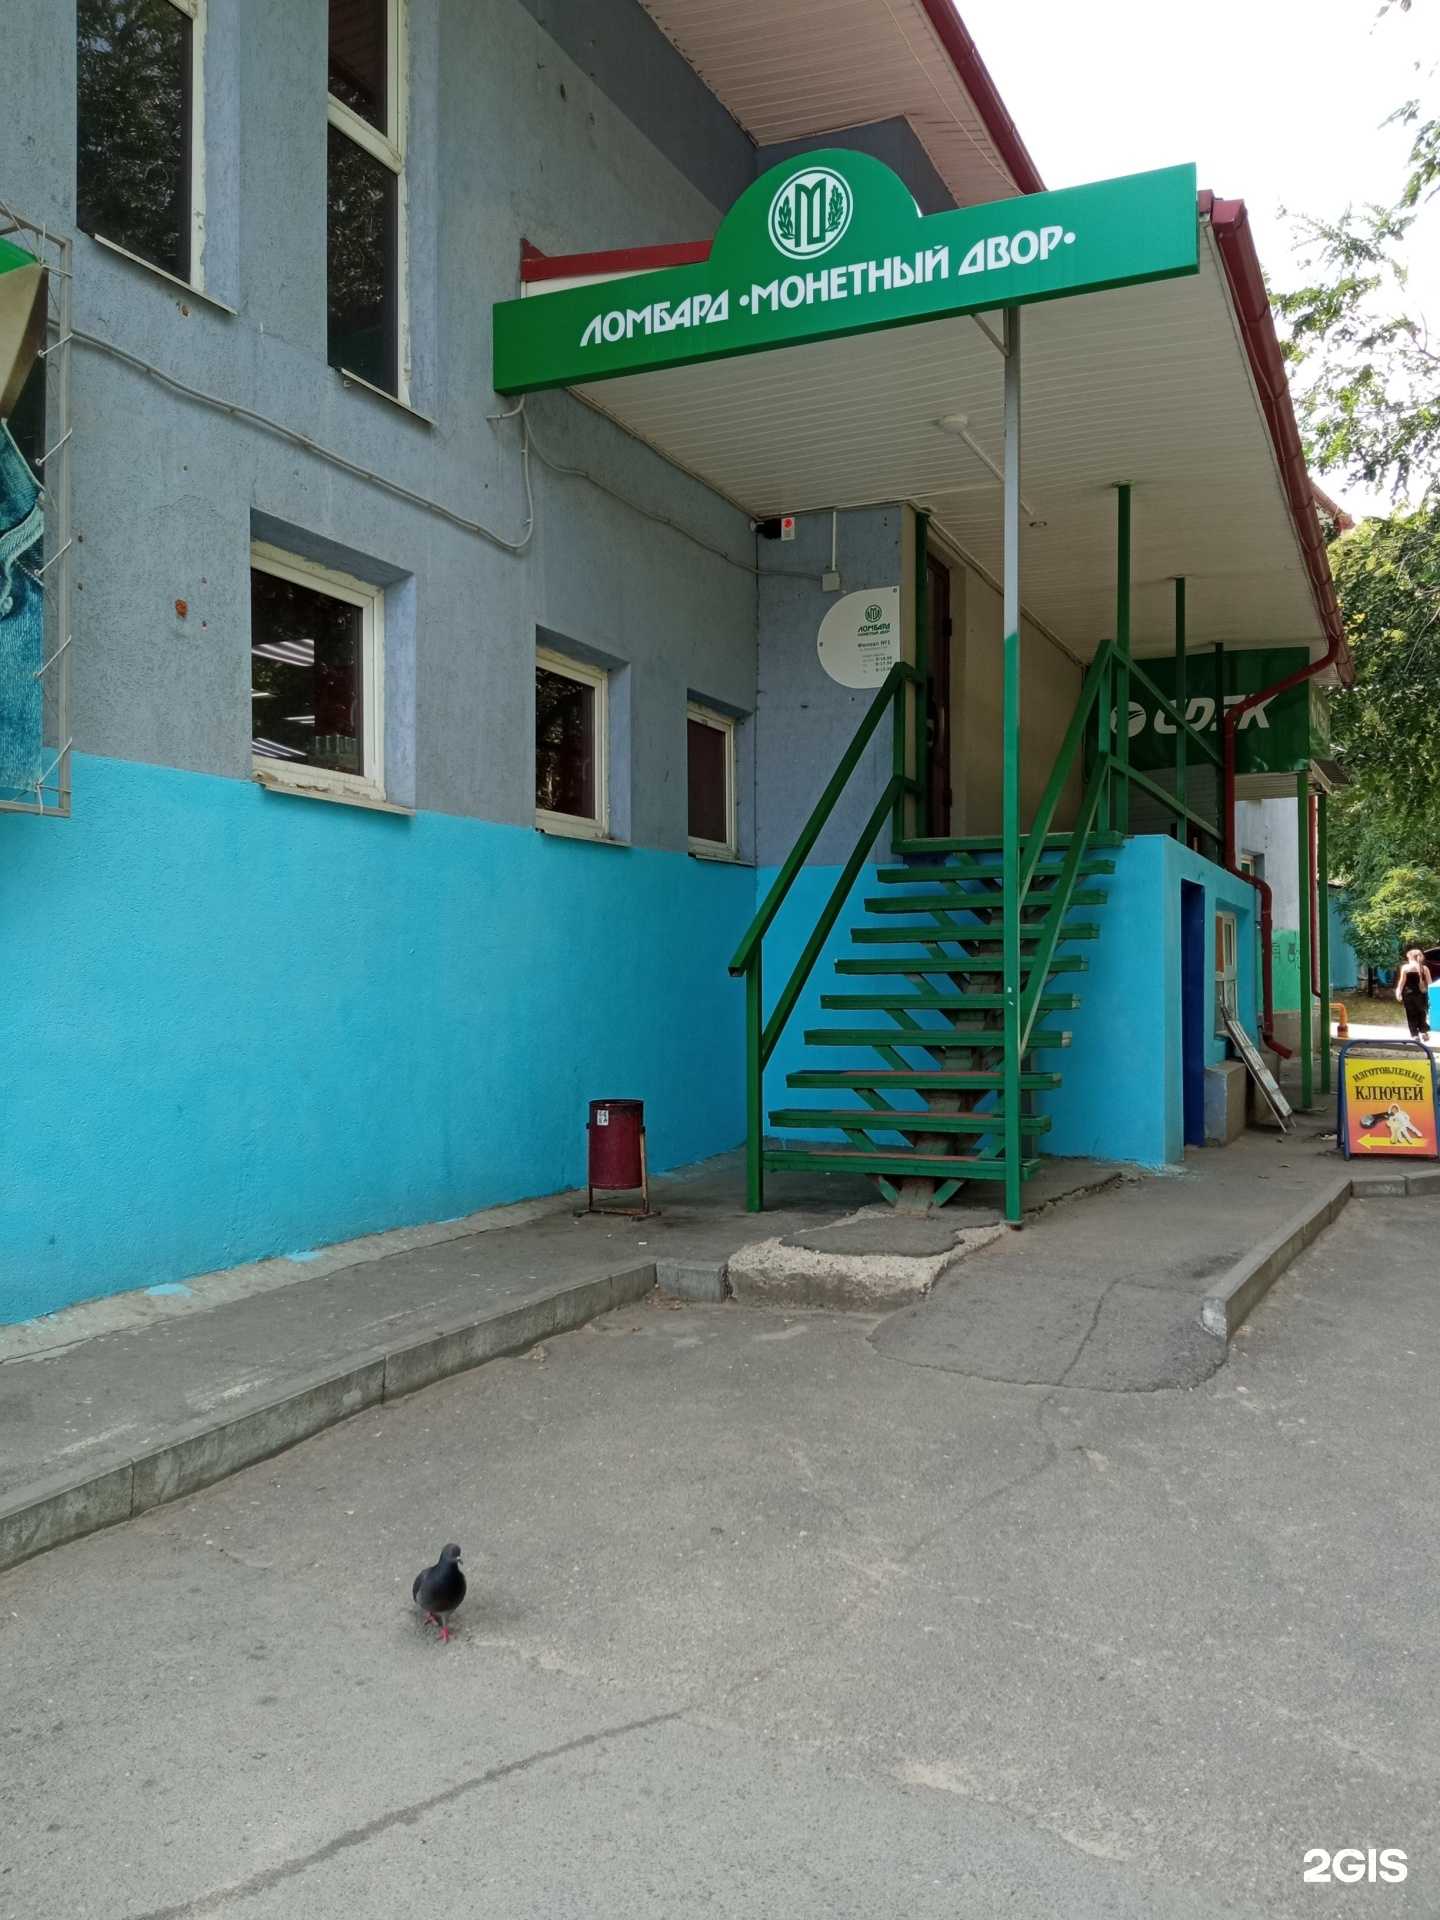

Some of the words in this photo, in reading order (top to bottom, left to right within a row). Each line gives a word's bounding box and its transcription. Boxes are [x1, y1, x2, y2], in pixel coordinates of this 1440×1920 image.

[579, 288, 729, 347] ЛОМБАРД
[1352, 1066, 1426, 1083] ИЗГОТОВЛЕНИЕ
[1355, 1084, 1424, 1101] КЛЮЧЕЙ
